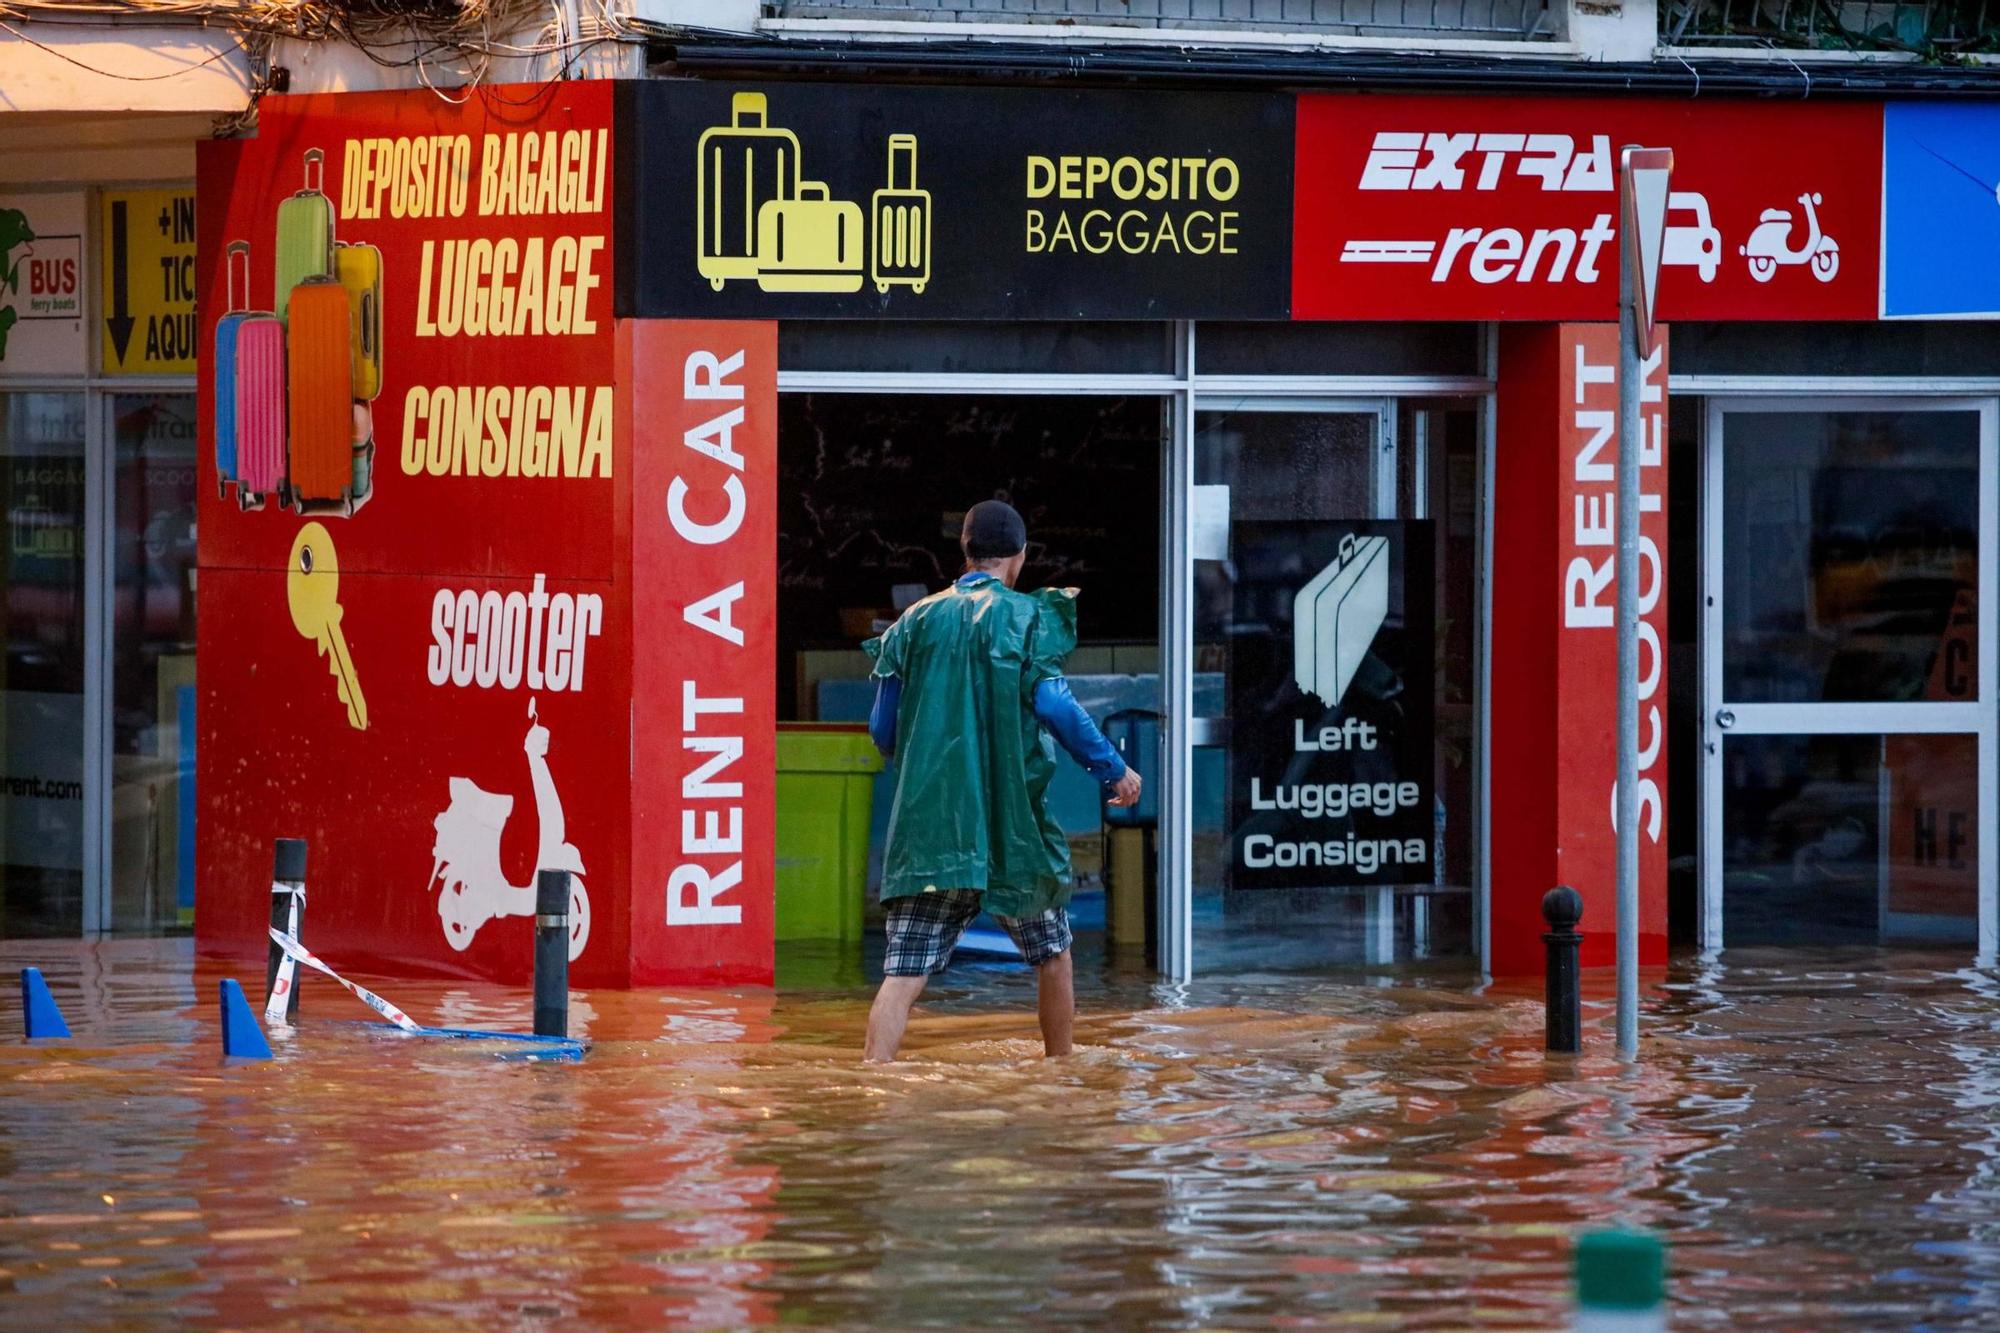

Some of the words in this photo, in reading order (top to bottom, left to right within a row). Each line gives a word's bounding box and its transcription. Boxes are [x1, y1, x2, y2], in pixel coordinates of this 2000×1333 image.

[340, 134, 471, 220] DEPOSITO
[478, 128, 608, 216] BAGAGLI
[1026, 155, 1240, 201] DEPOSITO
[1358, 132, 1614, 191] EXTRA
[1026, 209, 1239, 254] BAGGAGE
[1431, 214, 1615, 284] rent
[30, 258, 76, 295] BUS
[161, 255, 197, 302] TIC
[416, 235, 605, 337] LUGGAGE
[400, 385, 613, 478] CONSIGNA
[667, 349, 746, 545] CAR
[1565, 344, 1615, 627] RENT
[427, 573, 603, 692] scooter
[684, 580, 744, 647] A
[1295, 717, 1377, 752] Left
[0, 775, 82, 801] rent.com
[666, 680, 744, 926] RENT
[1251, 777, 1420, 818] Luggage
[1244, 832, 1426, 874] Consigna
